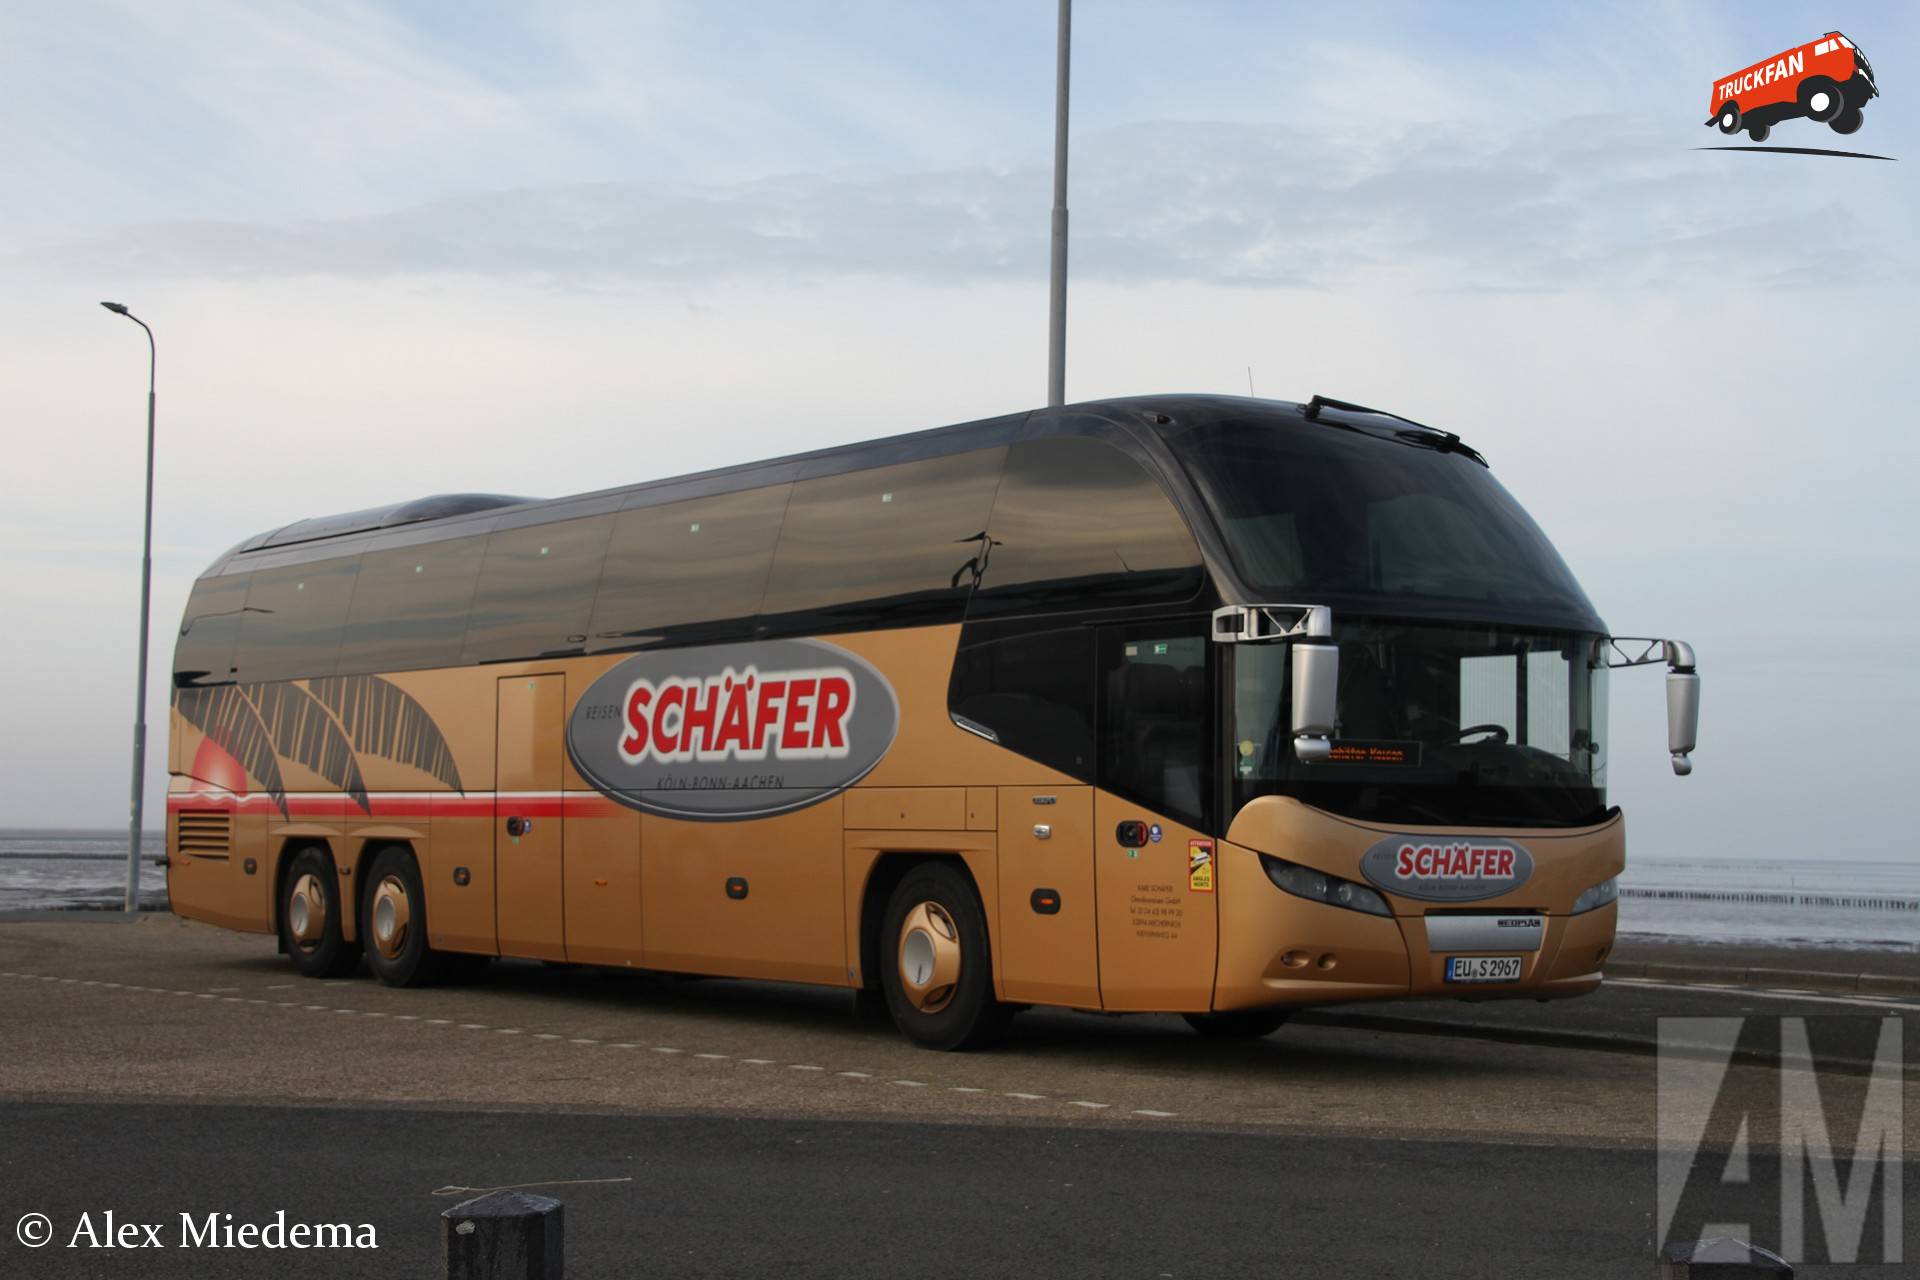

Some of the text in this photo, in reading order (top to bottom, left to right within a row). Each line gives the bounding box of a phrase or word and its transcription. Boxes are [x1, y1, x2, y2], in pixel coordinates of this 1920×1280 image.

[586, 672, 852, 757] REISEN SCHÄFER
[1396, 843, 1515, 877] SCHÄFER
[1455, 960, 1520, 977] EU S 2967
